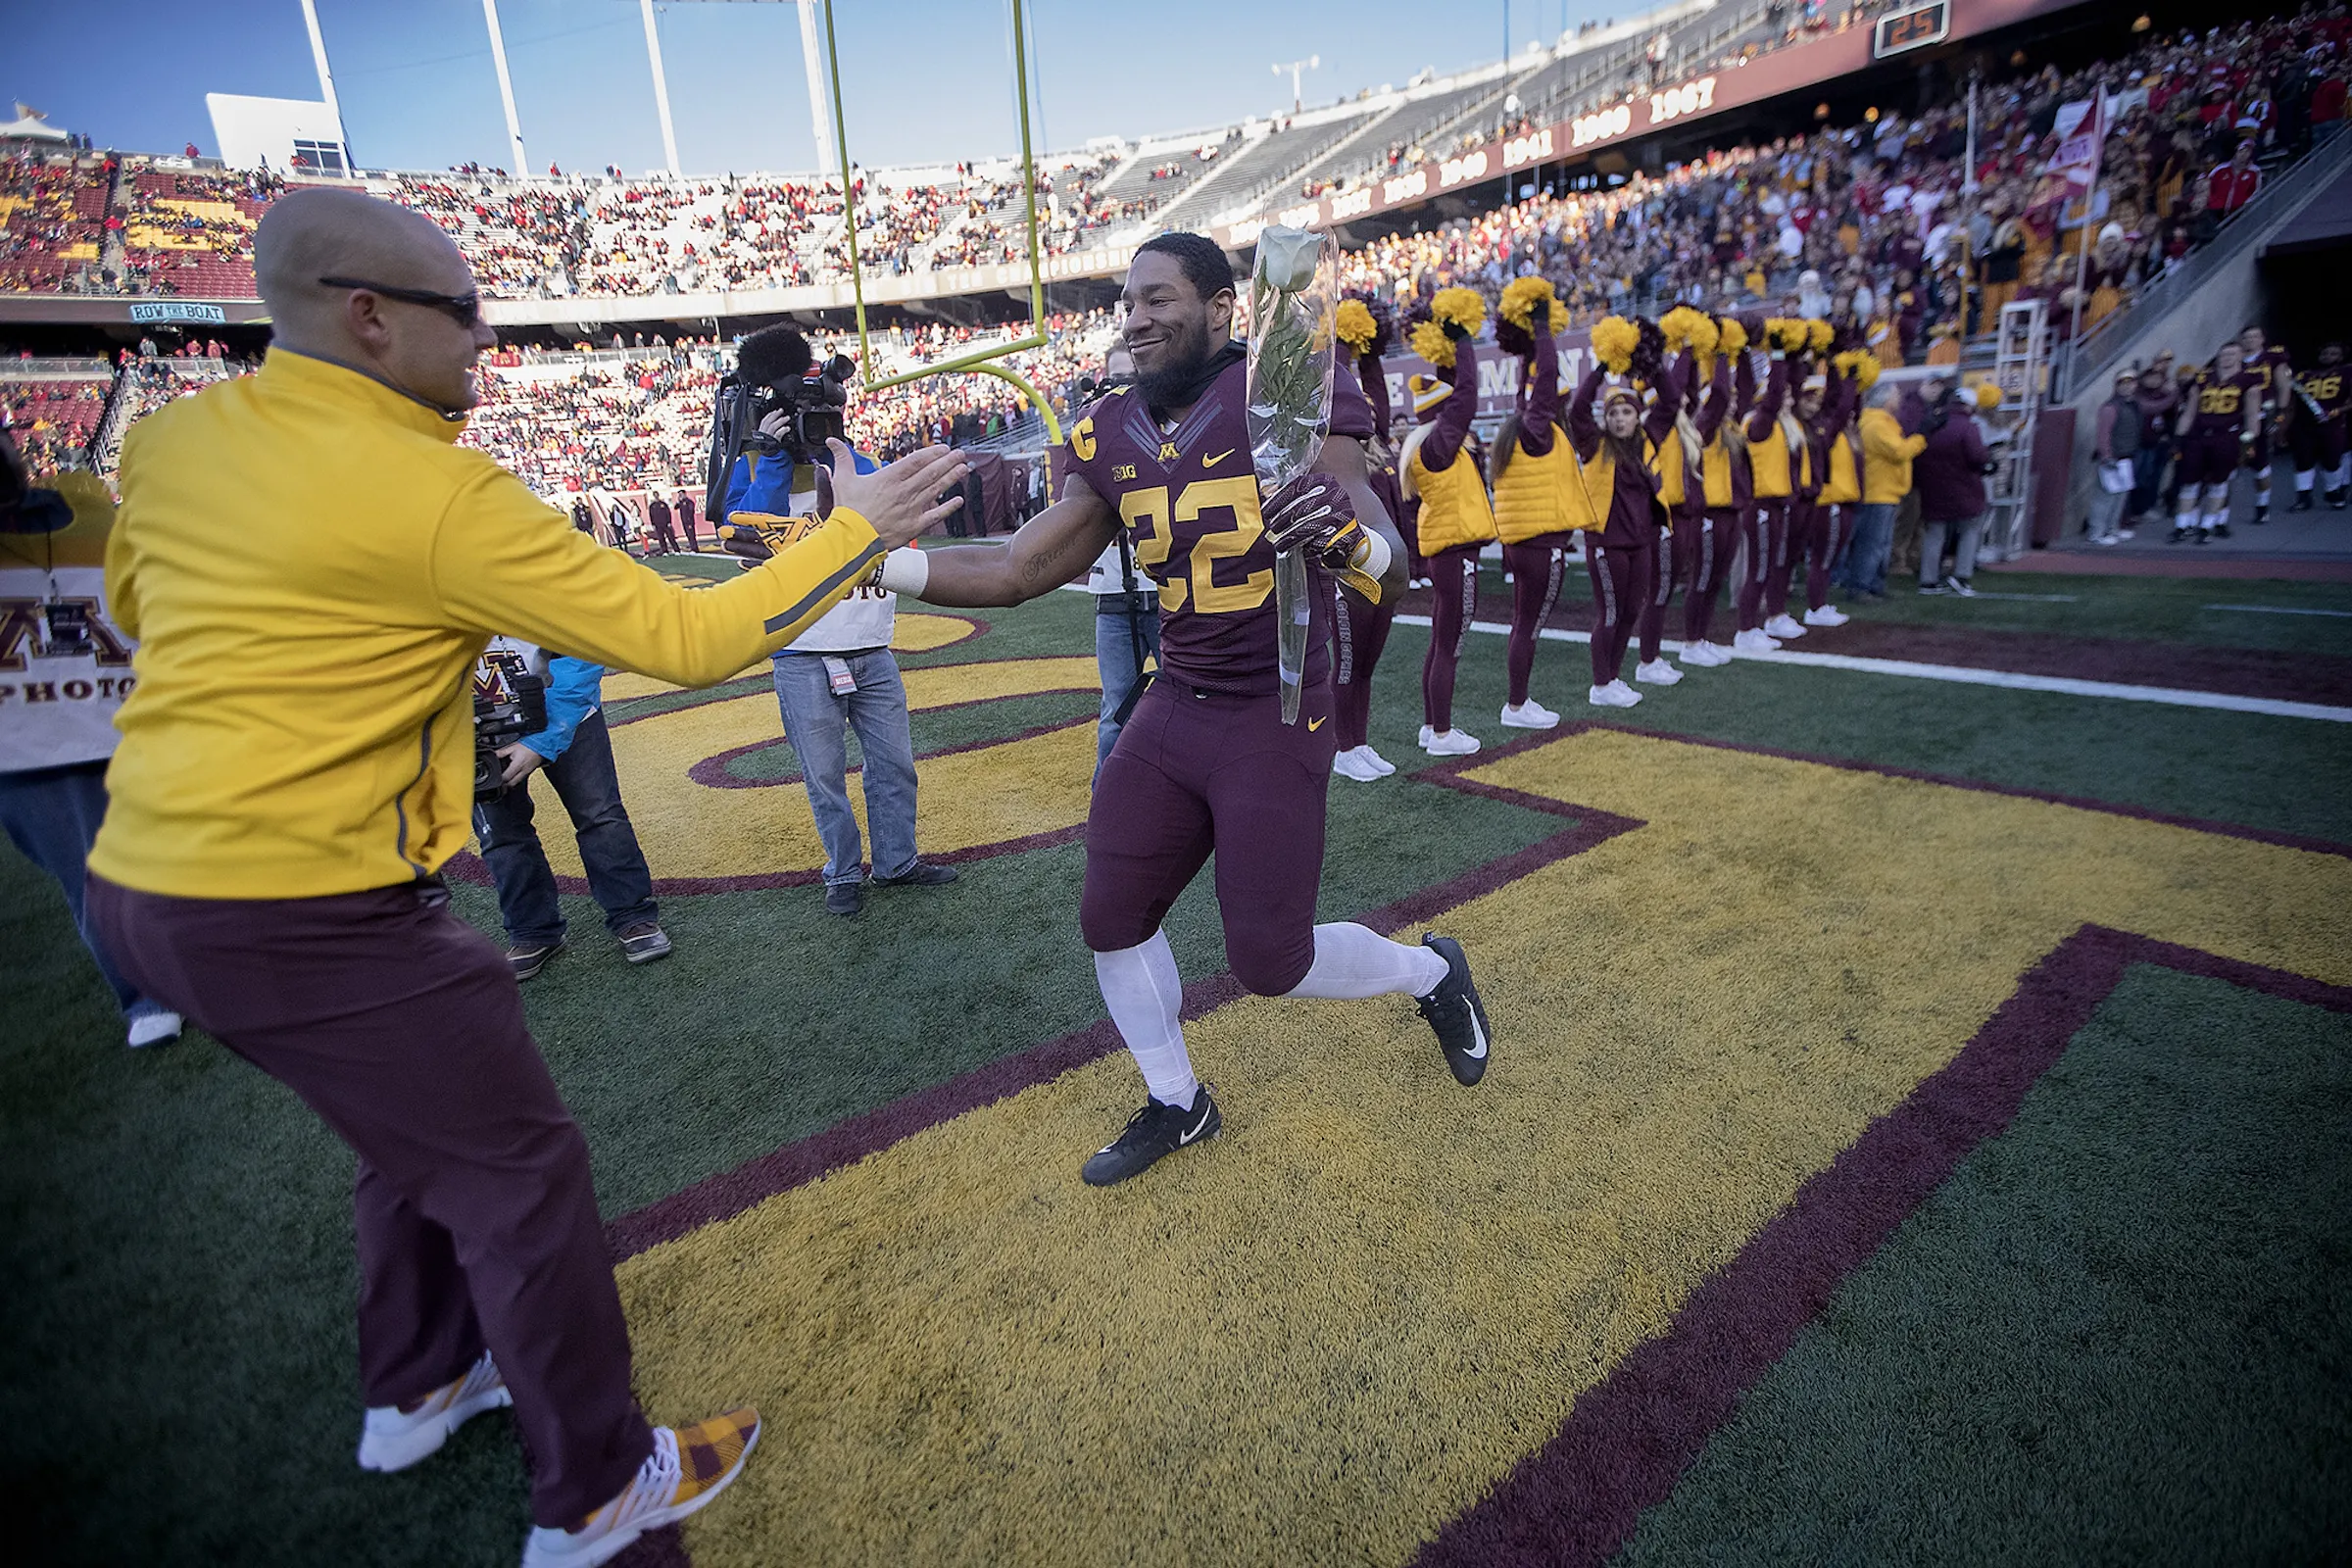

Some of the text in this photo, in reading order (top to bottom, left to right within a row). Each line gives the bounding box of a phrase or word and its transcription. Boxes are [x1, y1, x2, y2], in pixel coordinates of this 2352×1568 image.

[1890, 8, 1934, 47] 25
[134, 305, 221, 320] ROW THE BOAT
[1071, 416, 1097, 463] C
[1157, 442, 1180, 463] M
[1119, 474, 1276, 614] 22
